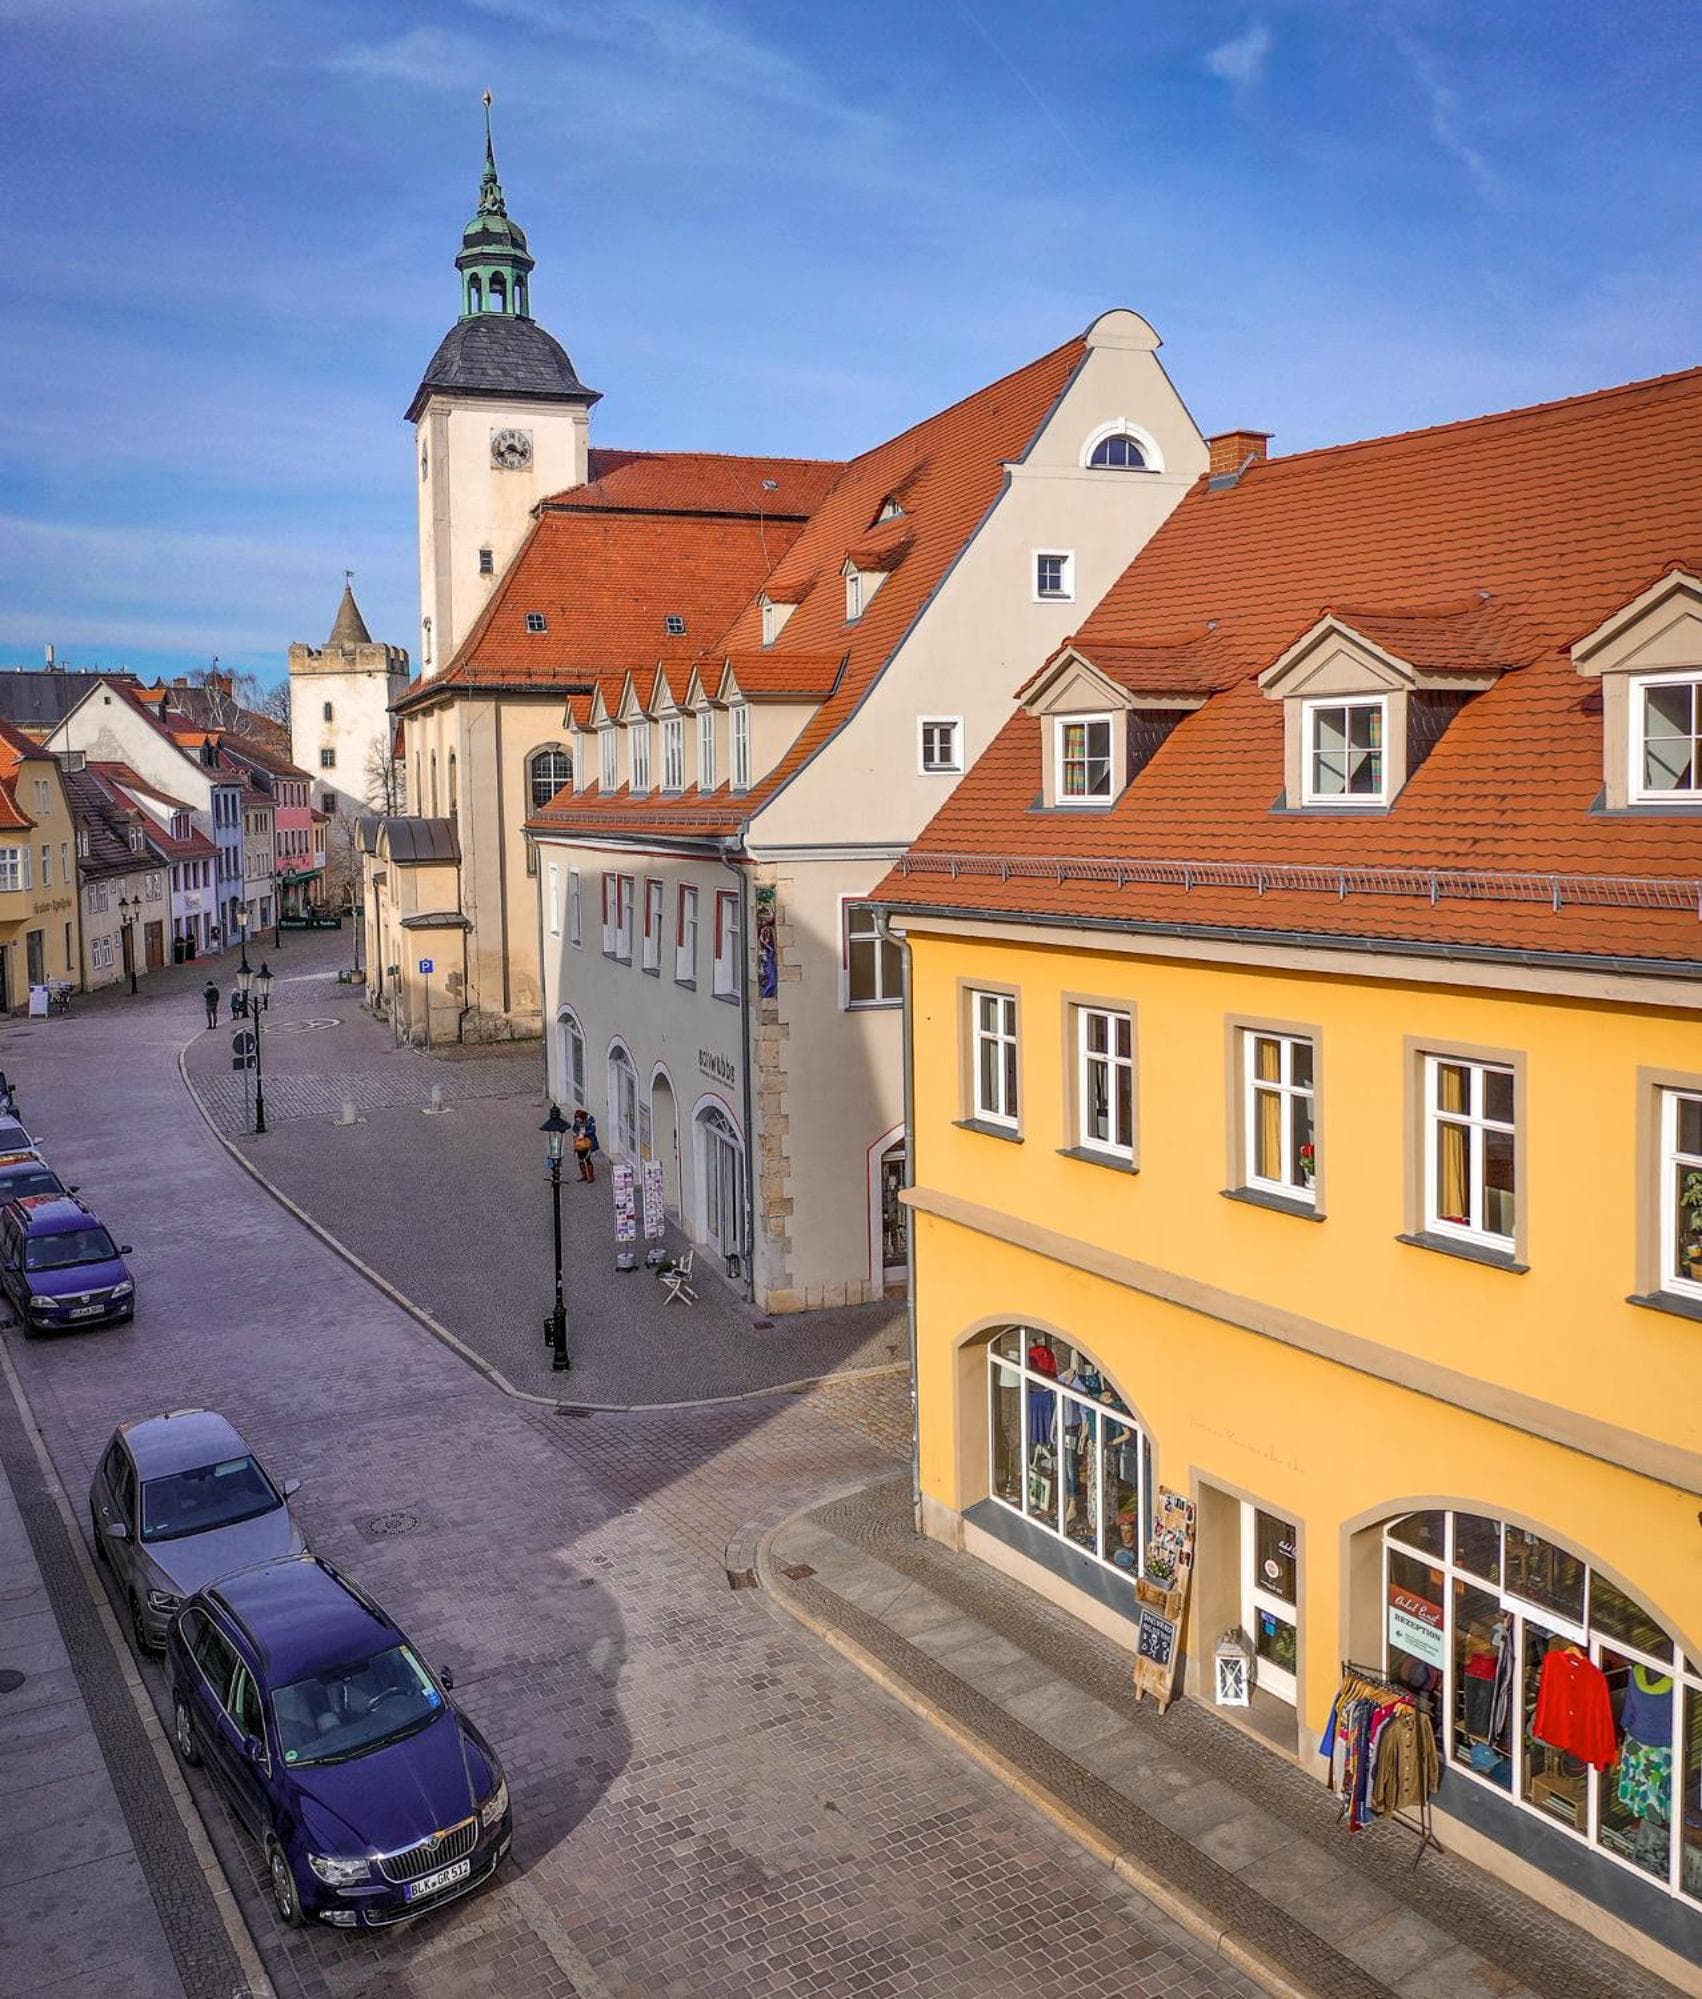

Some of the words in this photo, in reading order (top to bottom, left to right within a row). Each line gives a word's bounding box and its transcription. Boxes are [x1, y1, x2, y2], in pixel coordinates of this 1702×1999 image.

[421, 961, 431, 972] P
[1394, 1613, 1441, 1641] REZEPTION
[411, 1879, 430, 1896] BLK
[437, 1871, 450, 1885] GR
[451, 1862, 469, 1878] 512
